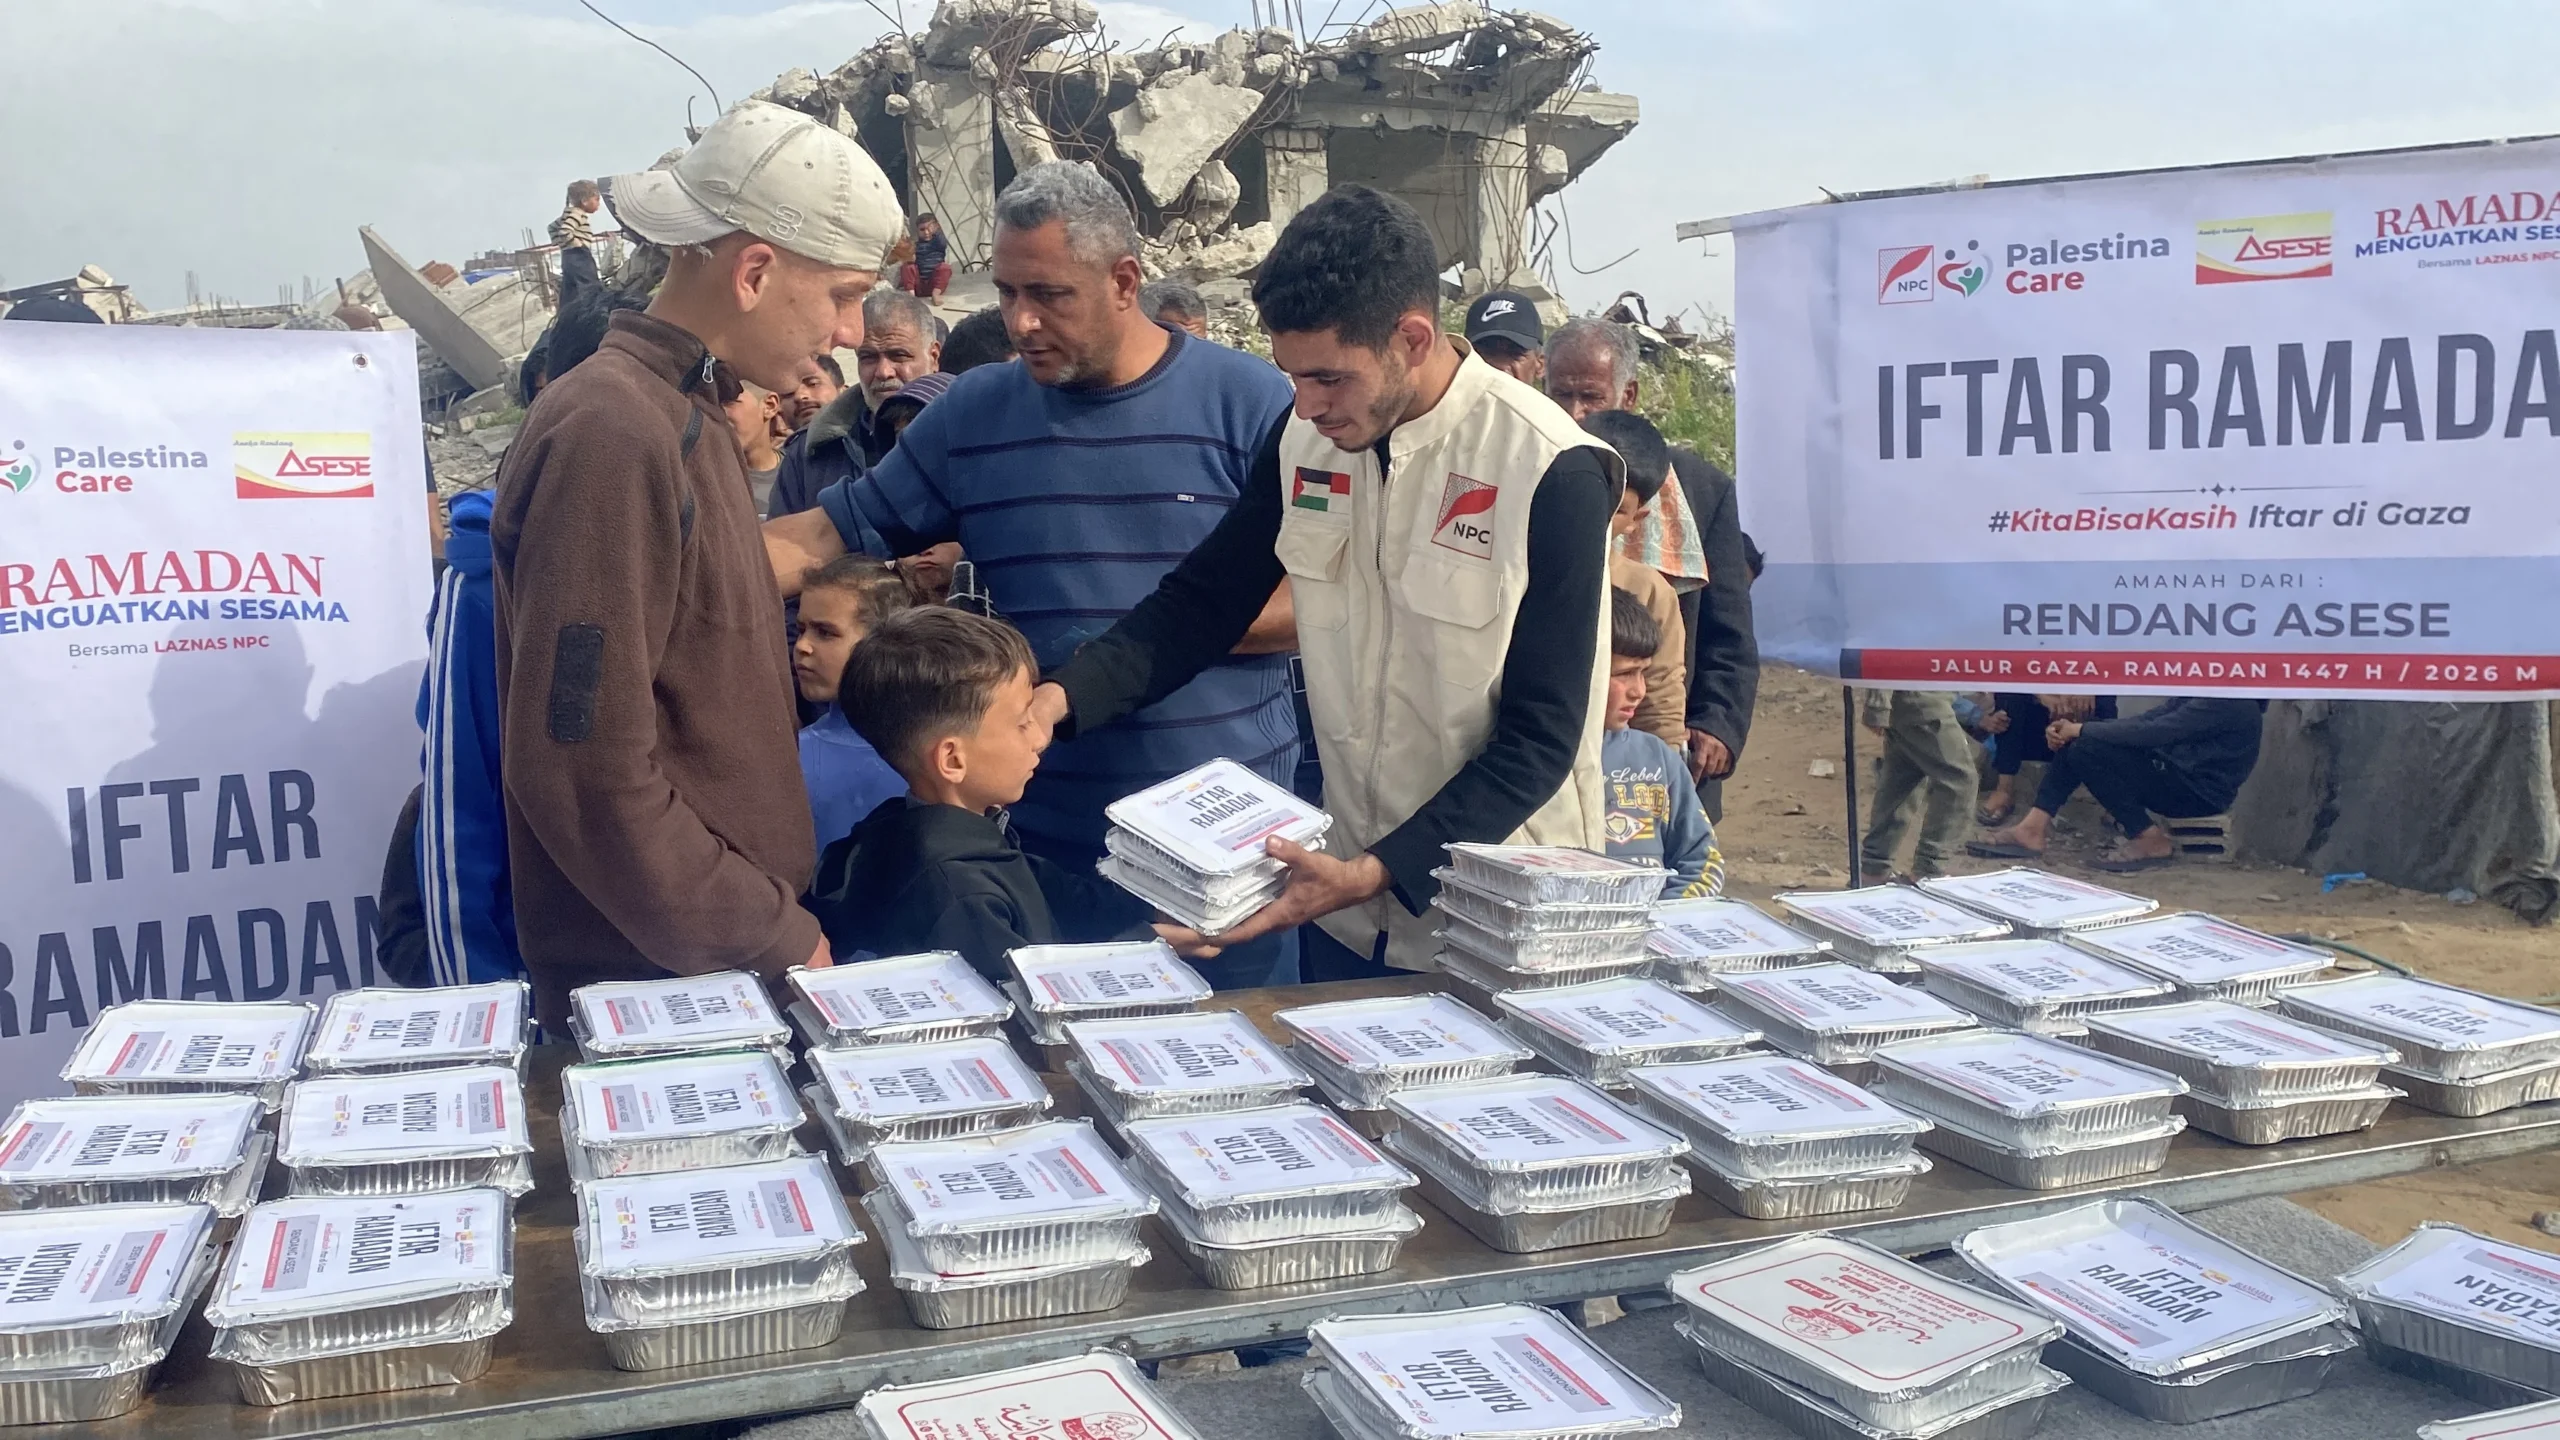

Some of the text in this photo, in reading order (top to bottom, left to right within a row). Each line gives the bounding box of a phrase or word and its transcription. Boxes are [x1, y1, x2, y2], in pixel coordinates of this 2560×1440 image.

[766, 203, 804, 242] 3
[2375, 191, 2560, 238] RAMADA
[2006, 232, 2171, 267] Palestina
[2234, 235, 2333, 262] ASESE
[2355, 225, 2560, 258] MENGUATKAN SES
[2418, 250, 2560, 268] Bersama LAZNAS NPC
[1898, 279, 1929, 293] NPC
[2006, 269, 2085, 295] Care
[1489, 300, 1515, 310] NIKE
[1877, 328, 2560, 461] IFTAR RAMADA
[54, 445, 208, 469] Palestina
[275, 449, 371, 477] ASESE
[55, 471, 133, 493] Care
[1453, 521, 1491, 544] NPC
[1987, 501, 2471, 534] #KitaBisaKasih Iftar di Gaza
[2114, 572, 2226, 589] AMANAH
[2240, 573, 2305, 589] DARI
[0, 599, 350, 635] ENGUATKAN SESAMA
[2002, 602, 2451, 638] RENDANG ASESE
[68, 635, 270, 657] Bersama LAZNAS NPC
[1929, 657, 2013, 676] JALUR
[2026, 658, 2110, 680] GAZA,
[2124, 660, 2269, 679] RAMADAN
[2282, 662, 2350, 681] 1447
[2365, 663, 2384, 681] H
[2424, 664, 2499, 682] 2026
[2516, 665, 2539, 682] M
[1185, 785, 1235, 809] IFTAR
[1190, 791, 1264, 829] RAMADAN
[67, 769, 321, 884] IFTAR
[1986, 963, 2065, 992] RAMADAN
[2027, 966, 2078, 985] IFTAR
[696, 995, 732, 1016] IFTAR
[900, 991, 937, 1011] IFTAR
[1788, 978, 1869, 1011] RAMADAN
[1829, 985, 1883, 1004] IFTAR
[368, 1019, 405, 1040] IFTAR
[401, 1010, 441, 1048] RAMADAN
[1575, 1005, 1650, 1038] RAMADAN
[1616, 1010, 1667, 1030] IFTAR
[2369, 1003, 2487, 1036] RAMADAN
[2417, 1005, 2488, 1028] IFTAR
[174, 1035, 223, 1075] RAMADAN
[216, 1044, 256, 1068] IFTAR
[1194, 1043, 1239, 1068] IFTAR
[1357, 1025, 1426, 1058] RAMADAN
[1396, 1029, 1444, 1050] IFTAR
[1155, 1038, 1217, 1078] RAMADAN
[868, 1076, 909, 1098] IFTAR
[898, 1067, 951, 1104] RAMADAN
[1958, 1060, 2064, 1096] RAMADAN
[2006, 1064, 2074, 1087] IFTAR
[664, 1083, 708, 1125] RAMADAN
[703, 1088, 742, 1114] IFTAR
[1699, 1083, 1759, 1104] IFTAR
[1717, 1074, 1809, 1112] RAMADAN
[362, 1102, 398, 1126] IFTAR
[402, 1092, 437, 1132] RAMADAN
[1458, 1116, 1515, 1140] IFTAR
[1479, 1106, 1565, 1146] RAMADAN
[71, 1124, 132, 1167] RAMADAN
[121, 1129, 170, 1157] IFTAR
[1213, 1135, 1267, 1165] IFTAR
[1240, 1126, 1316, 1171] RAMADAN
[938, 1171, 987, 1196] IFTAR
[972, 1161, 1036, 1201] RAMADAN
[648, 1203, 691, 1234] IFTAR
[689, 1189, 738, 1239] RAMADAN
[348, 1214, 396, 1275] RAMADAN
[398, 1221, 441, 1258] IFTAR
[5, 1242, 82, 1304] RAMADAN
[2139, 1268, 2223, 1303] IFTAR
[2080, 1264, 2214, 1324] RAMADAN
[2469, 1294, 2560, 1332] FTAR
[1402, 1362, 1472, 1402] IFTAR
[1430, 1349, 1533, 1414] RAMADAN
